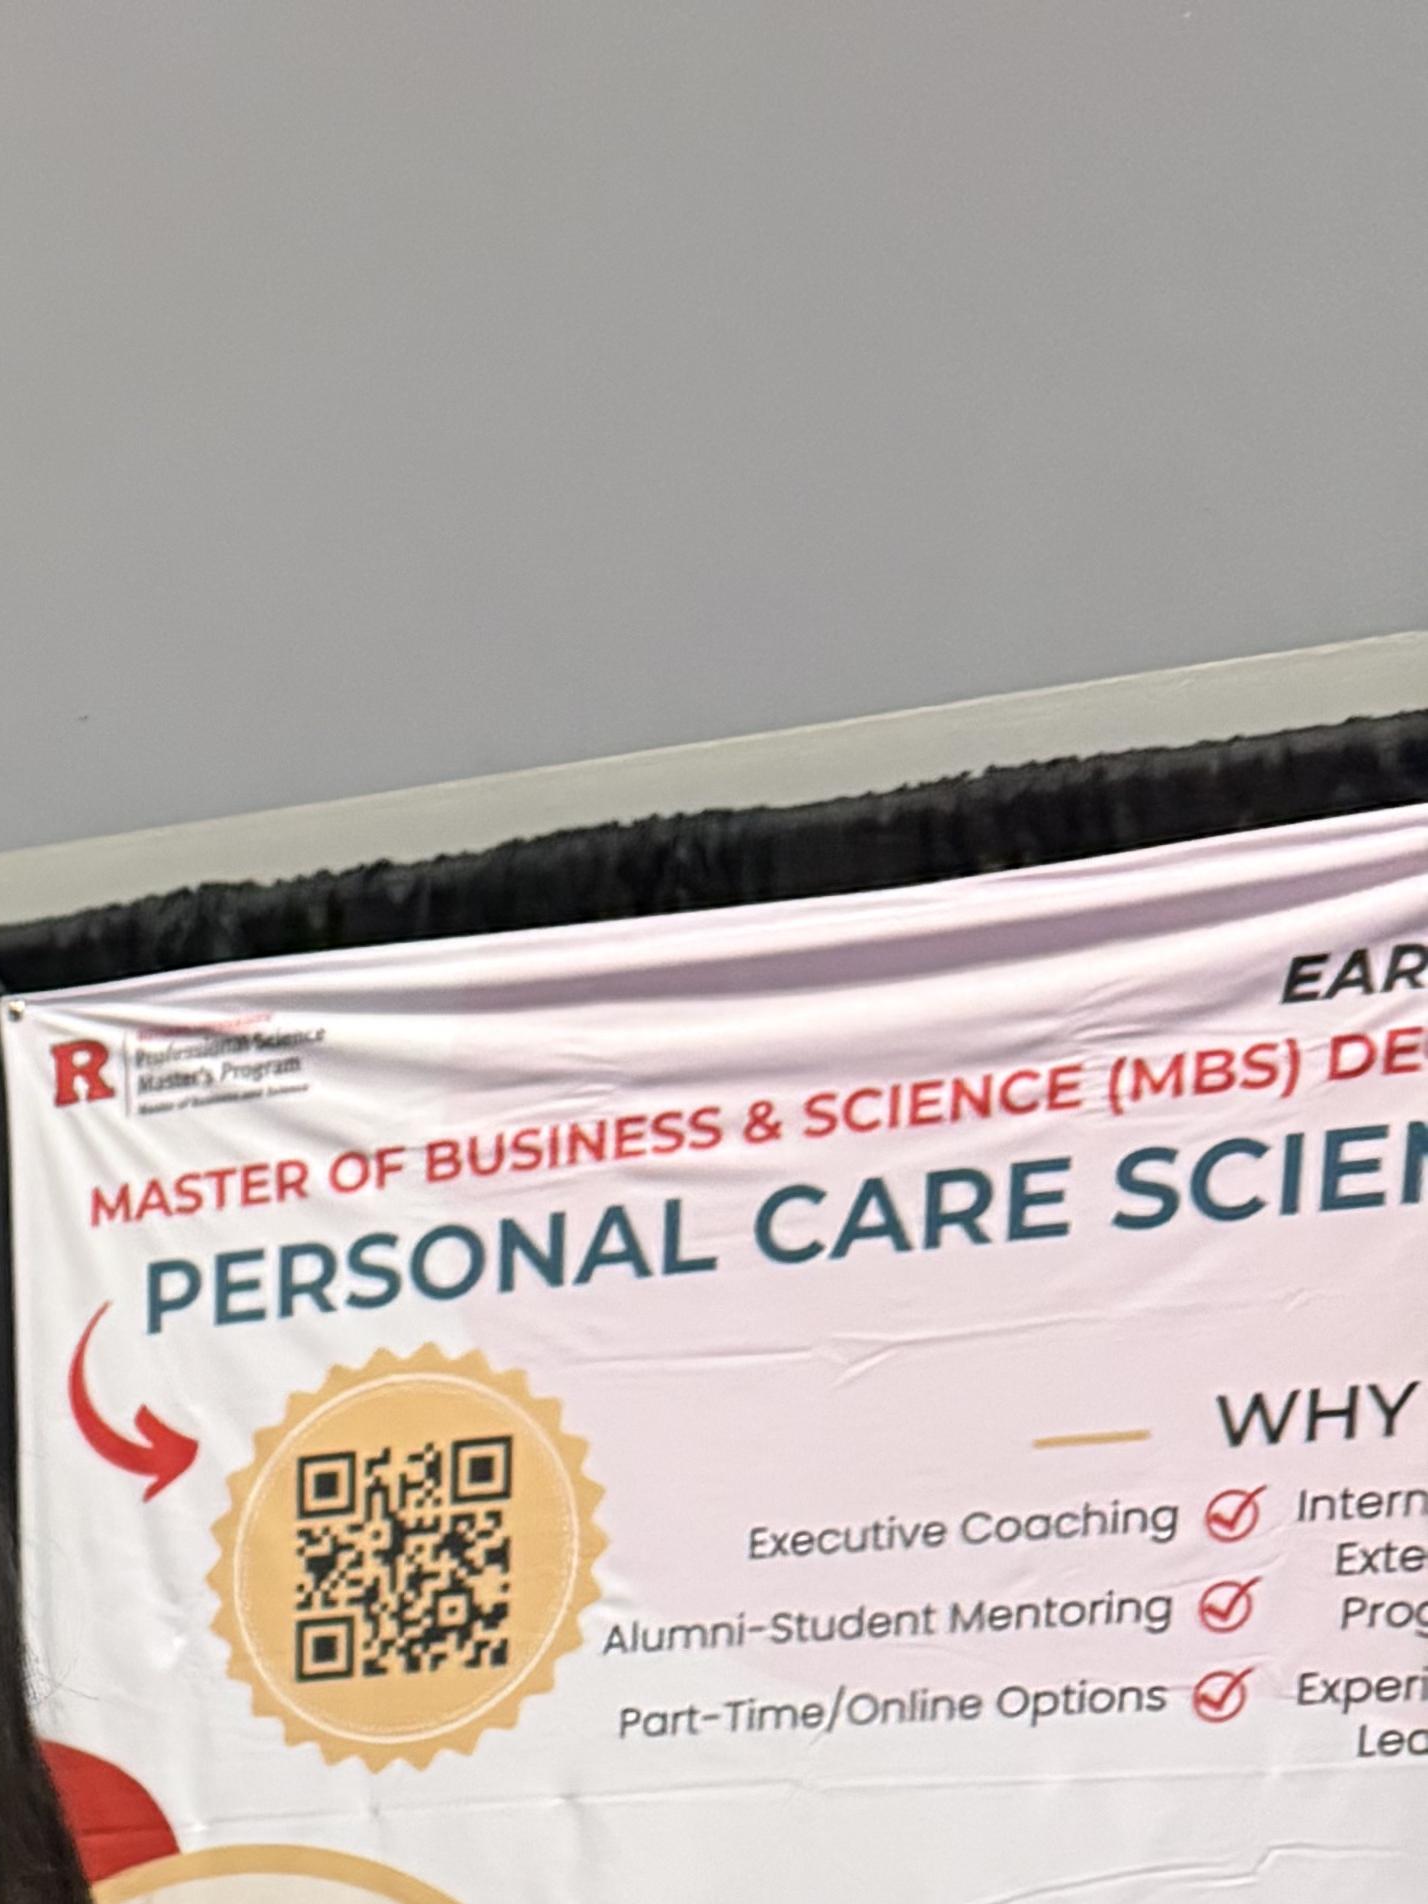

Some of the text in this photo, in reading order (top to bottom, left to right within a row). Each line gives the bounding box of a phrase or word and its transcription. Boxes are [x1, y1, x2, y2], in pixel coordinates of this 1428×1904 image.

[1281, 942, 1428, 1004] EAR
[51, 1038, 116, 1108] R
[219, 1055, 302, 1082] Program
[90, 1025, 1428, 1228] MASTER OF BUSINESS & SCIENCE (MBS) DE
[146, 1198, 719, 1335] PERSONAL
[753, 1156, 1073, 1266] CARE
[1214, 1379, 1422, 1449] WHY
[747, 1499, 1180, 1560] Executive Coaching
[1296, 1487, 1428, 1523] Intern
[1334, 1541, 1428, 1577] Exte
[603, 1590, 1172, 1656] Alumni-Student Mentoring
[618, 1680, 1168, 1741] Part-Time/Online Options
